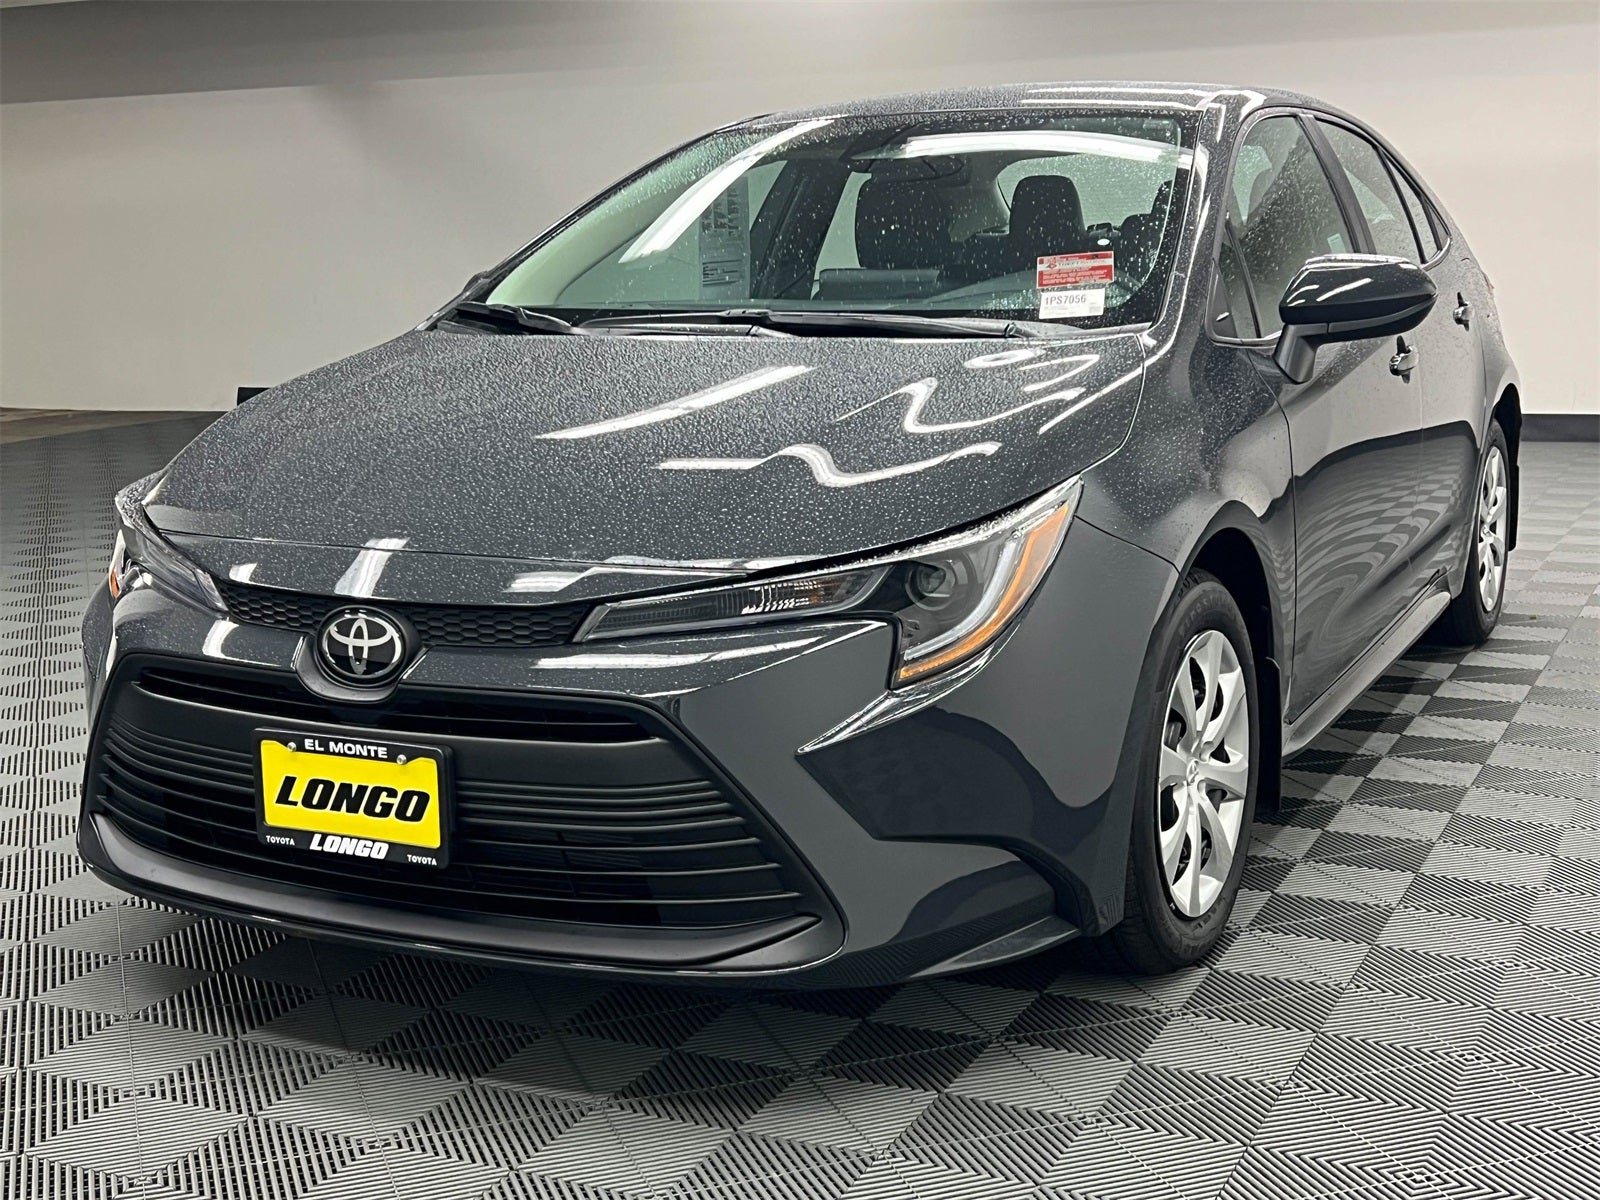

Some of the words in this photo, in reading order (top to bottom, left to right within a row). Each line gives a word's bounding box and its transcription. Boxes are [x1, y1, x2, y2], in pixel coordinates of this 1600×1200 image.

[1045, 295, 1087, 305] 1PS7056
[304, 738, 325, 752] EL
[329, 741, 388, 759] MONTE
[275, 775, 431, 823] LONGO
[265, 835, 295, 846] TOYOTA
[309, 833, 390, 860] LONGO
[407, 854, 437, 866] TOYOTA
